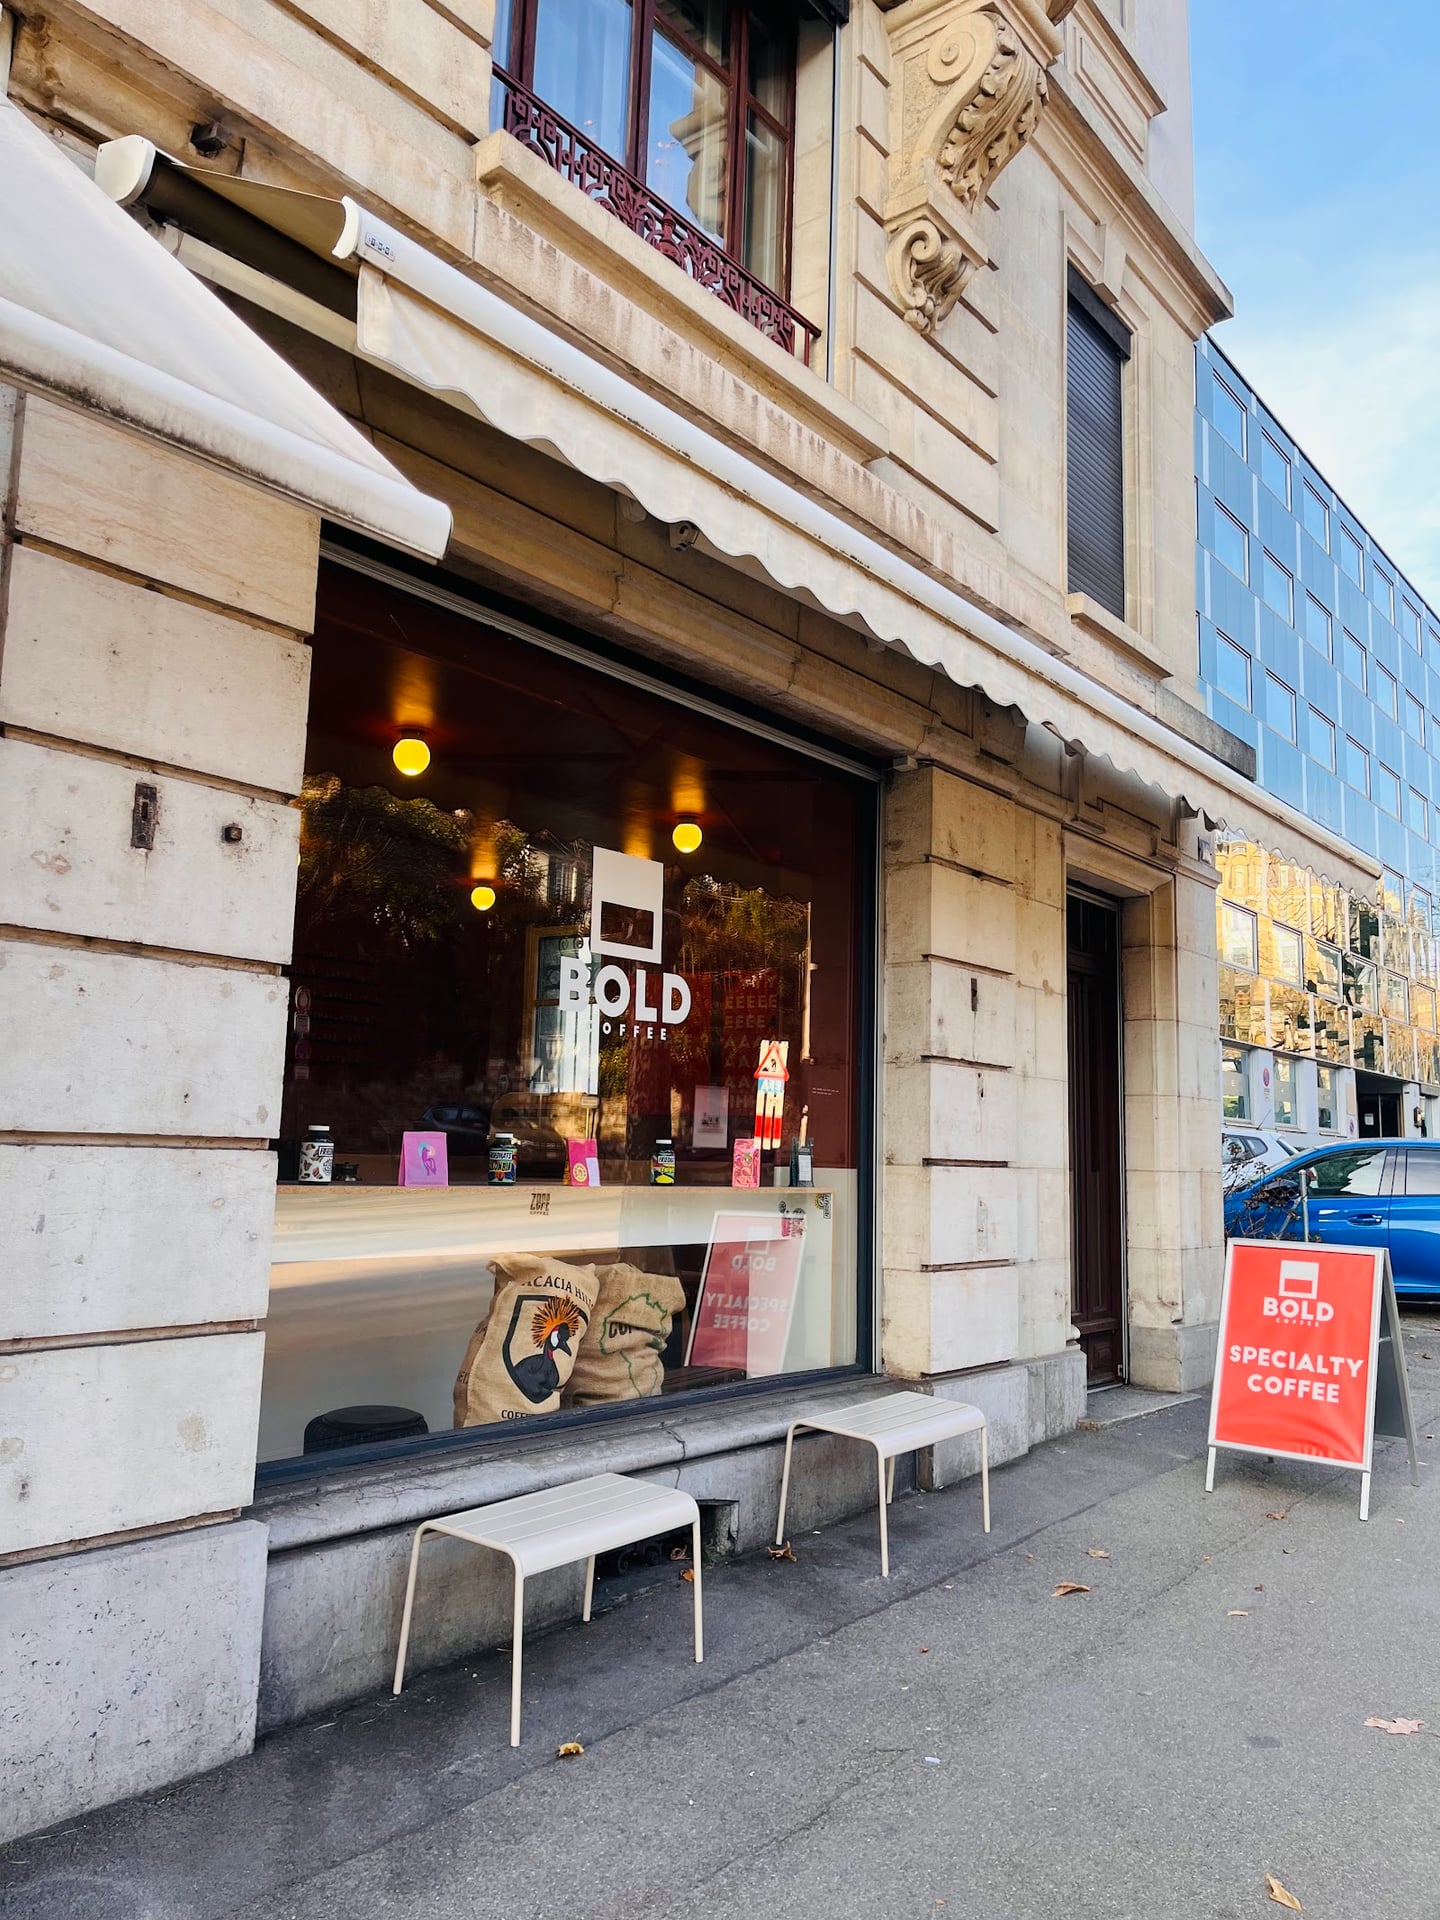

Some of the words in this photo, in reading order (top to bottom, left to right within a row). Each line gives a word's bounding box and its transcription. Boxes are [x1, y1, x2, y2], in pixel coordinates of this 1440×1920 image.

[558, 956, 692, 1024] BOLD
[1262, 1296, 1335, 1322] BOLD
[1229, 1344, 1364, 1379] SPECIALTY
[1247, 1373, 1340, 1404] COFFEE
